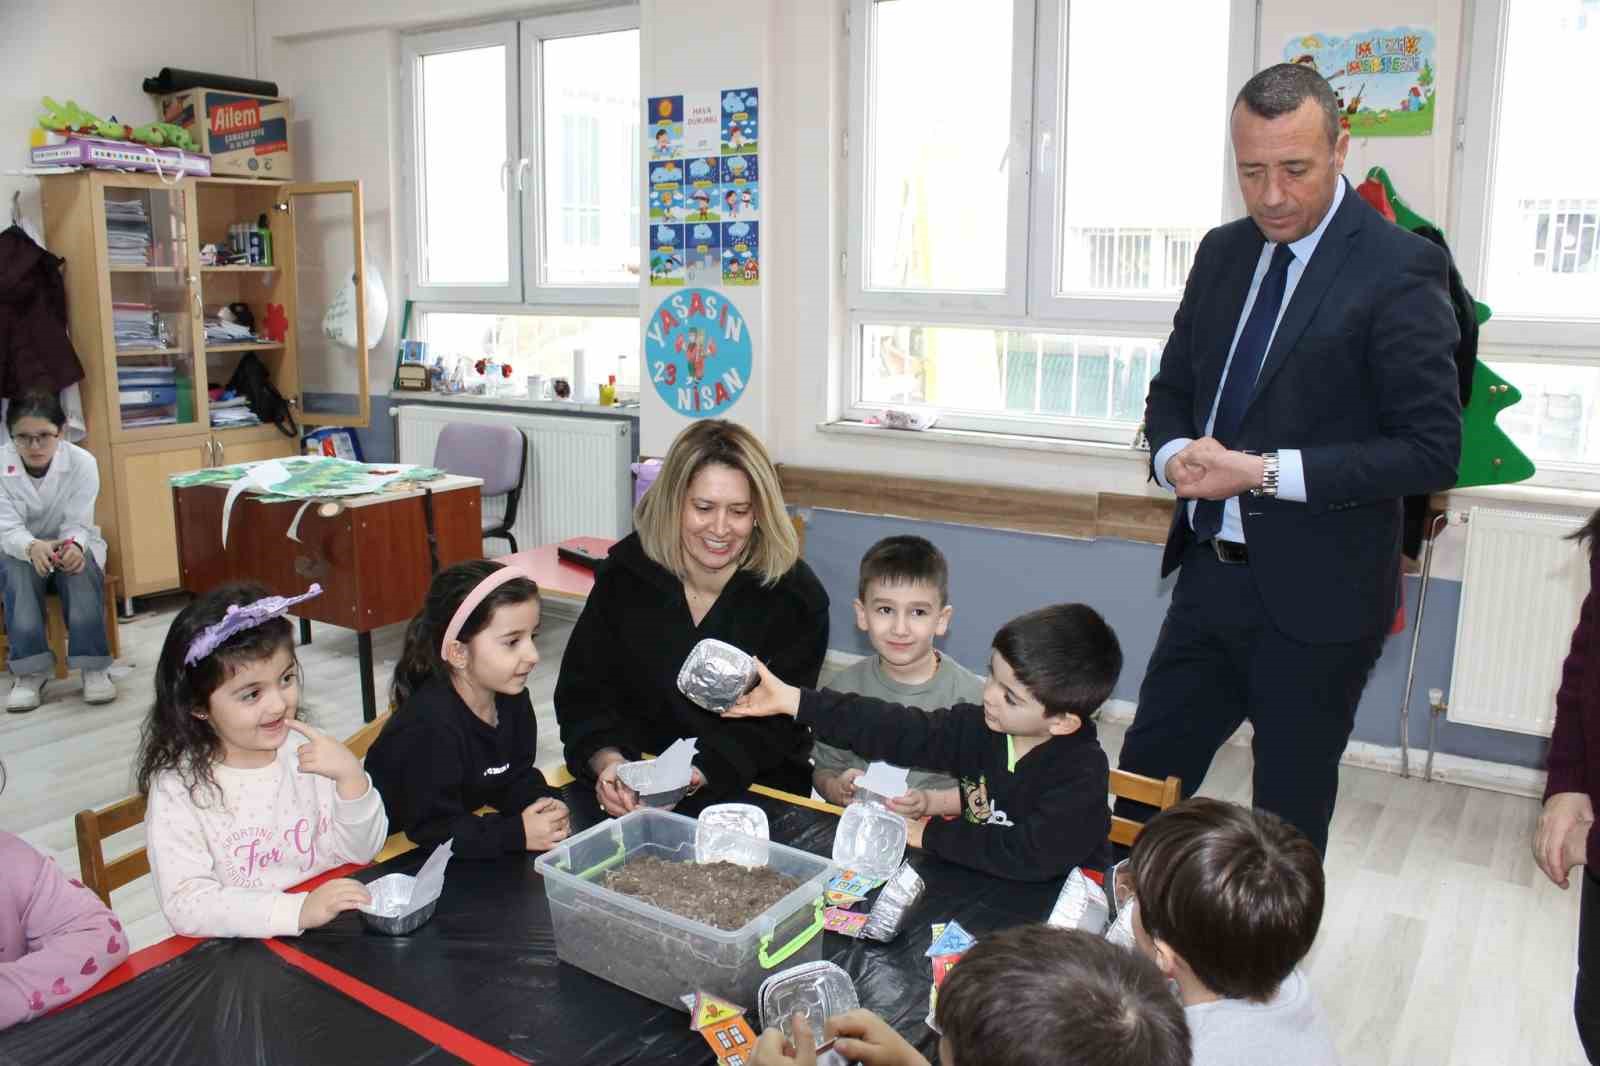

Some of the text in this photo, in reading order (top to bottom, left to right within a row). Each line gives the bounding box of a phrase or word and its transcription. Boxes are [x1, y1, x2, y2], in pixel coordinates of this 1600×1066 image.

[214, 106, 257, 131] Ailem
[647, 292, 743, 348] YAŞASIN
[654, 360, 676, 385] 23
[234, 838, 283, 878] For
